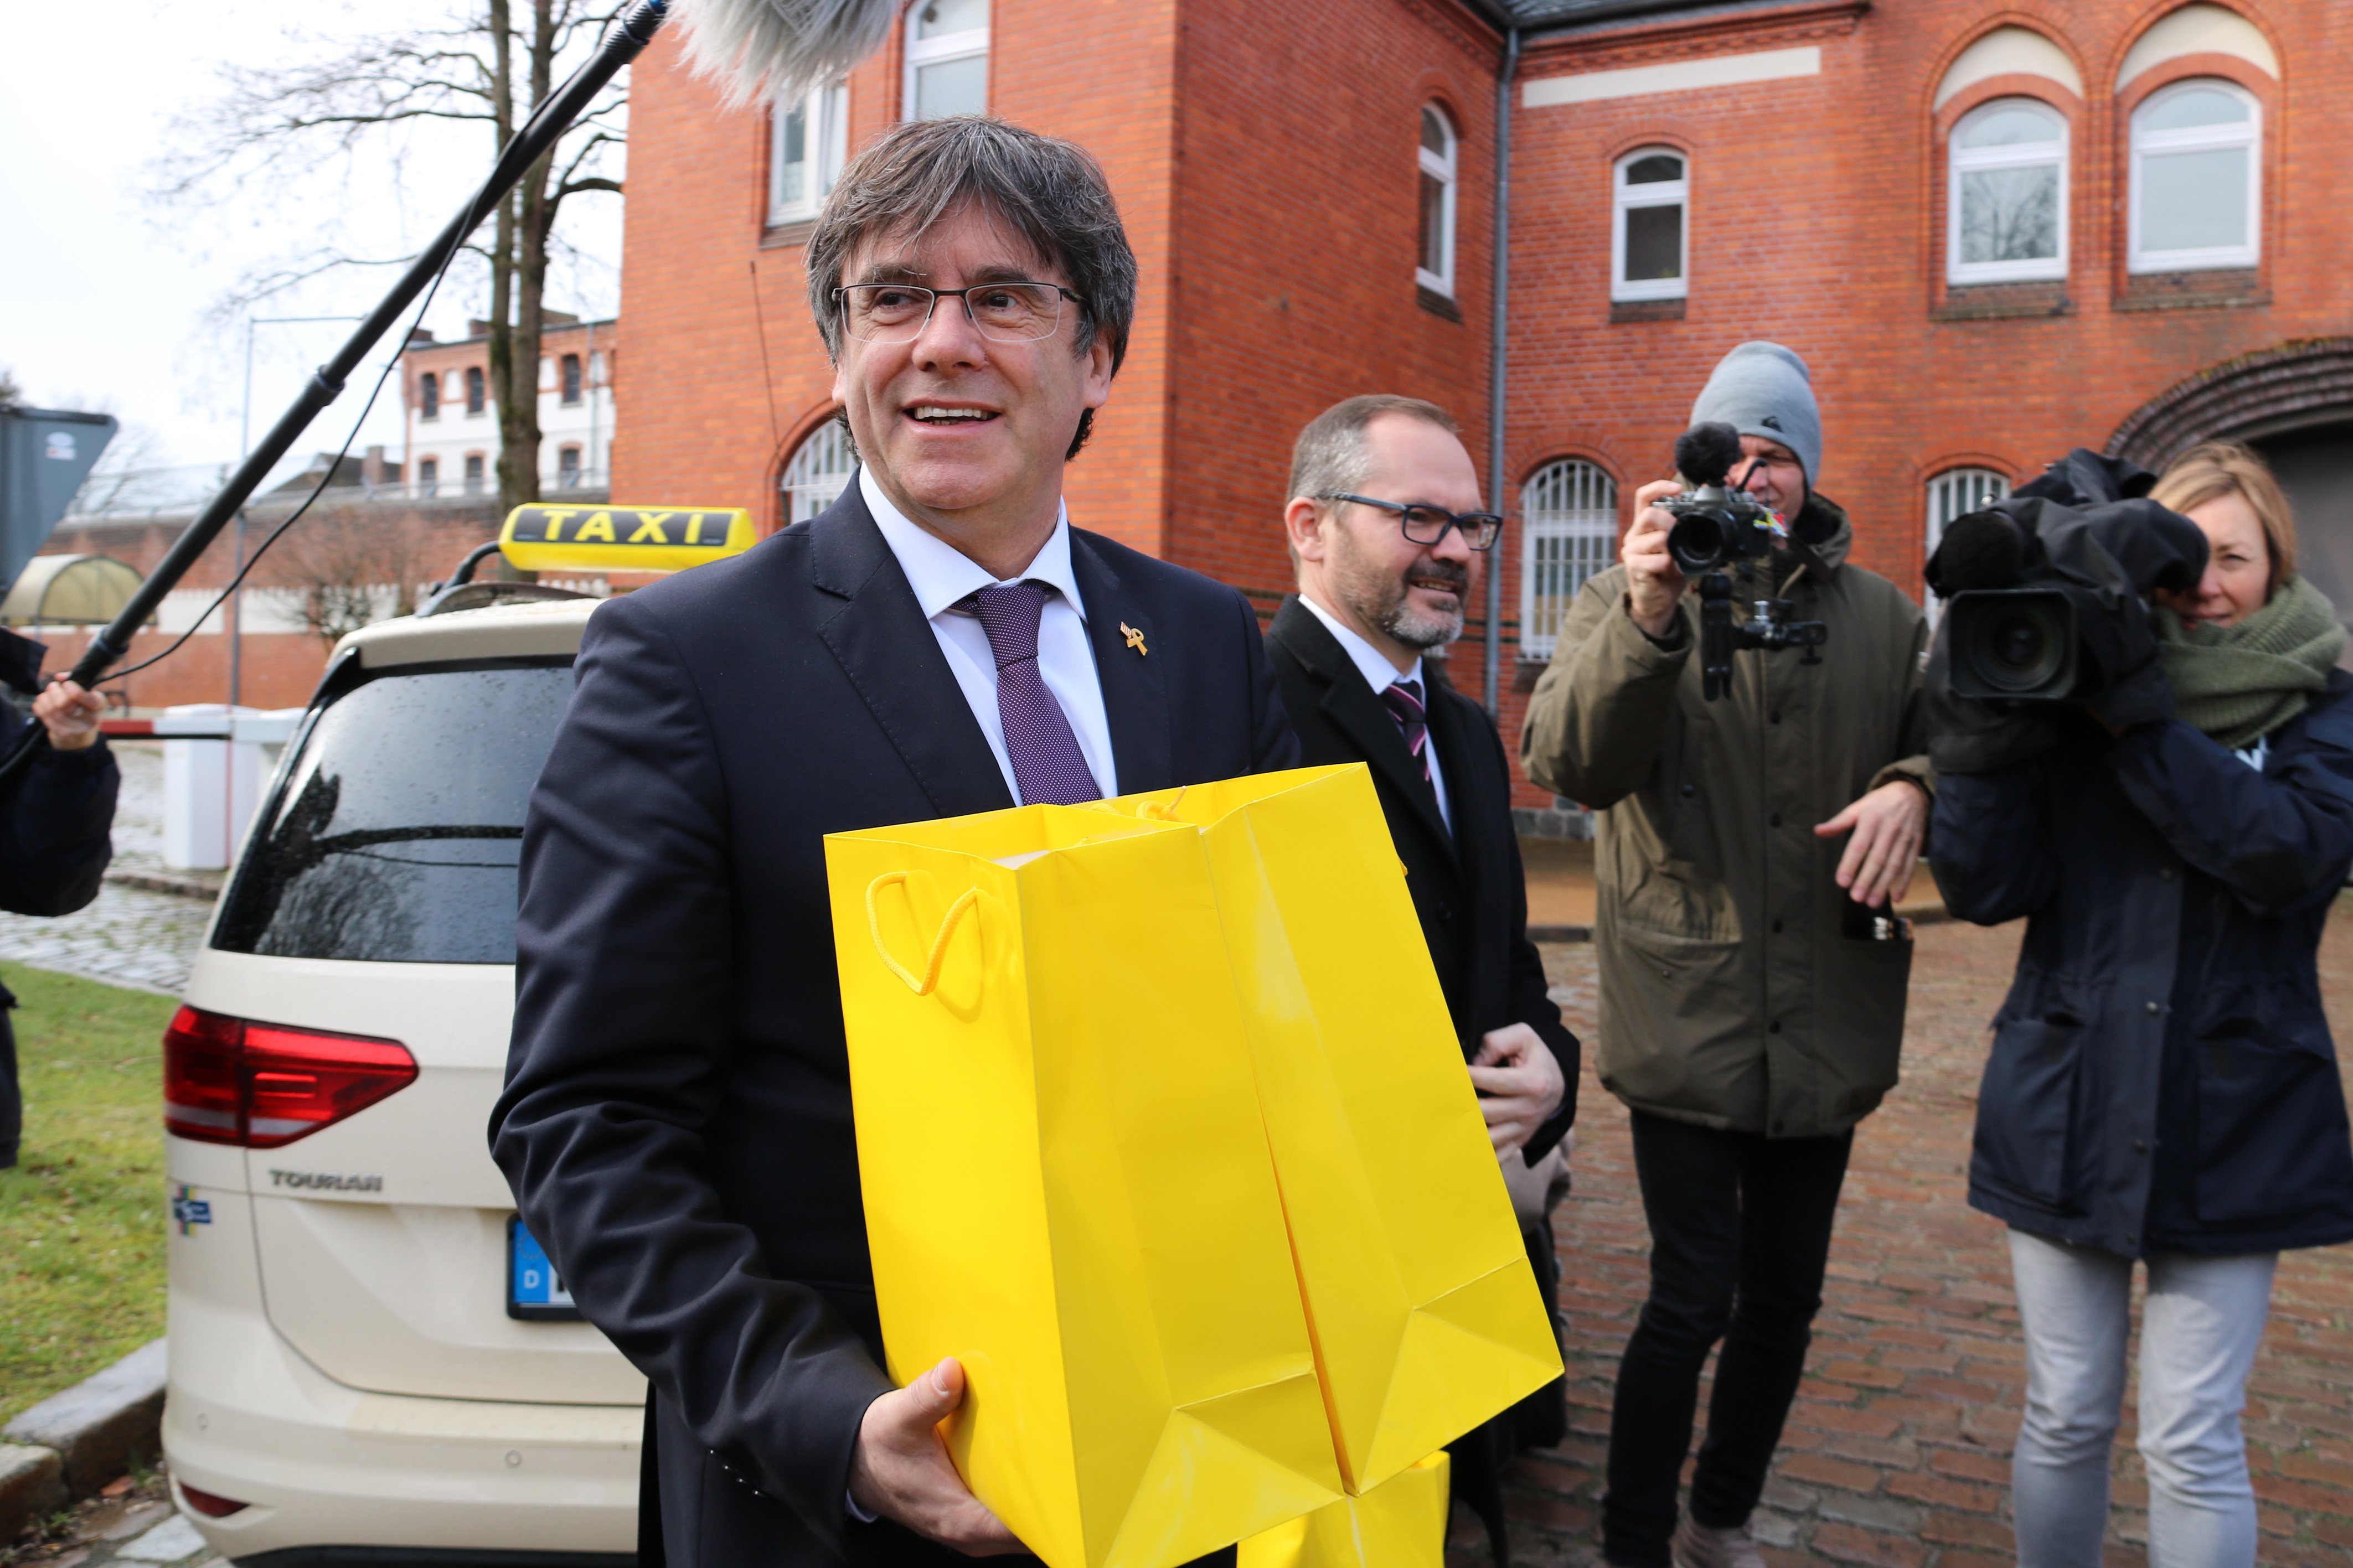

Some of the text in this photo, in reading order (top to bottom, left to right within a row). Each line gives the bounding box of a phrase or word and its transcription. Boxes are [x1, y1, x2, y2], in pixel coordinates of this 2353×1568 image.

[541, 510, 704, 544] TAXI
[269, 1168, 383, 1192] TOURAN
[524, 1269, 540, 1289] D
